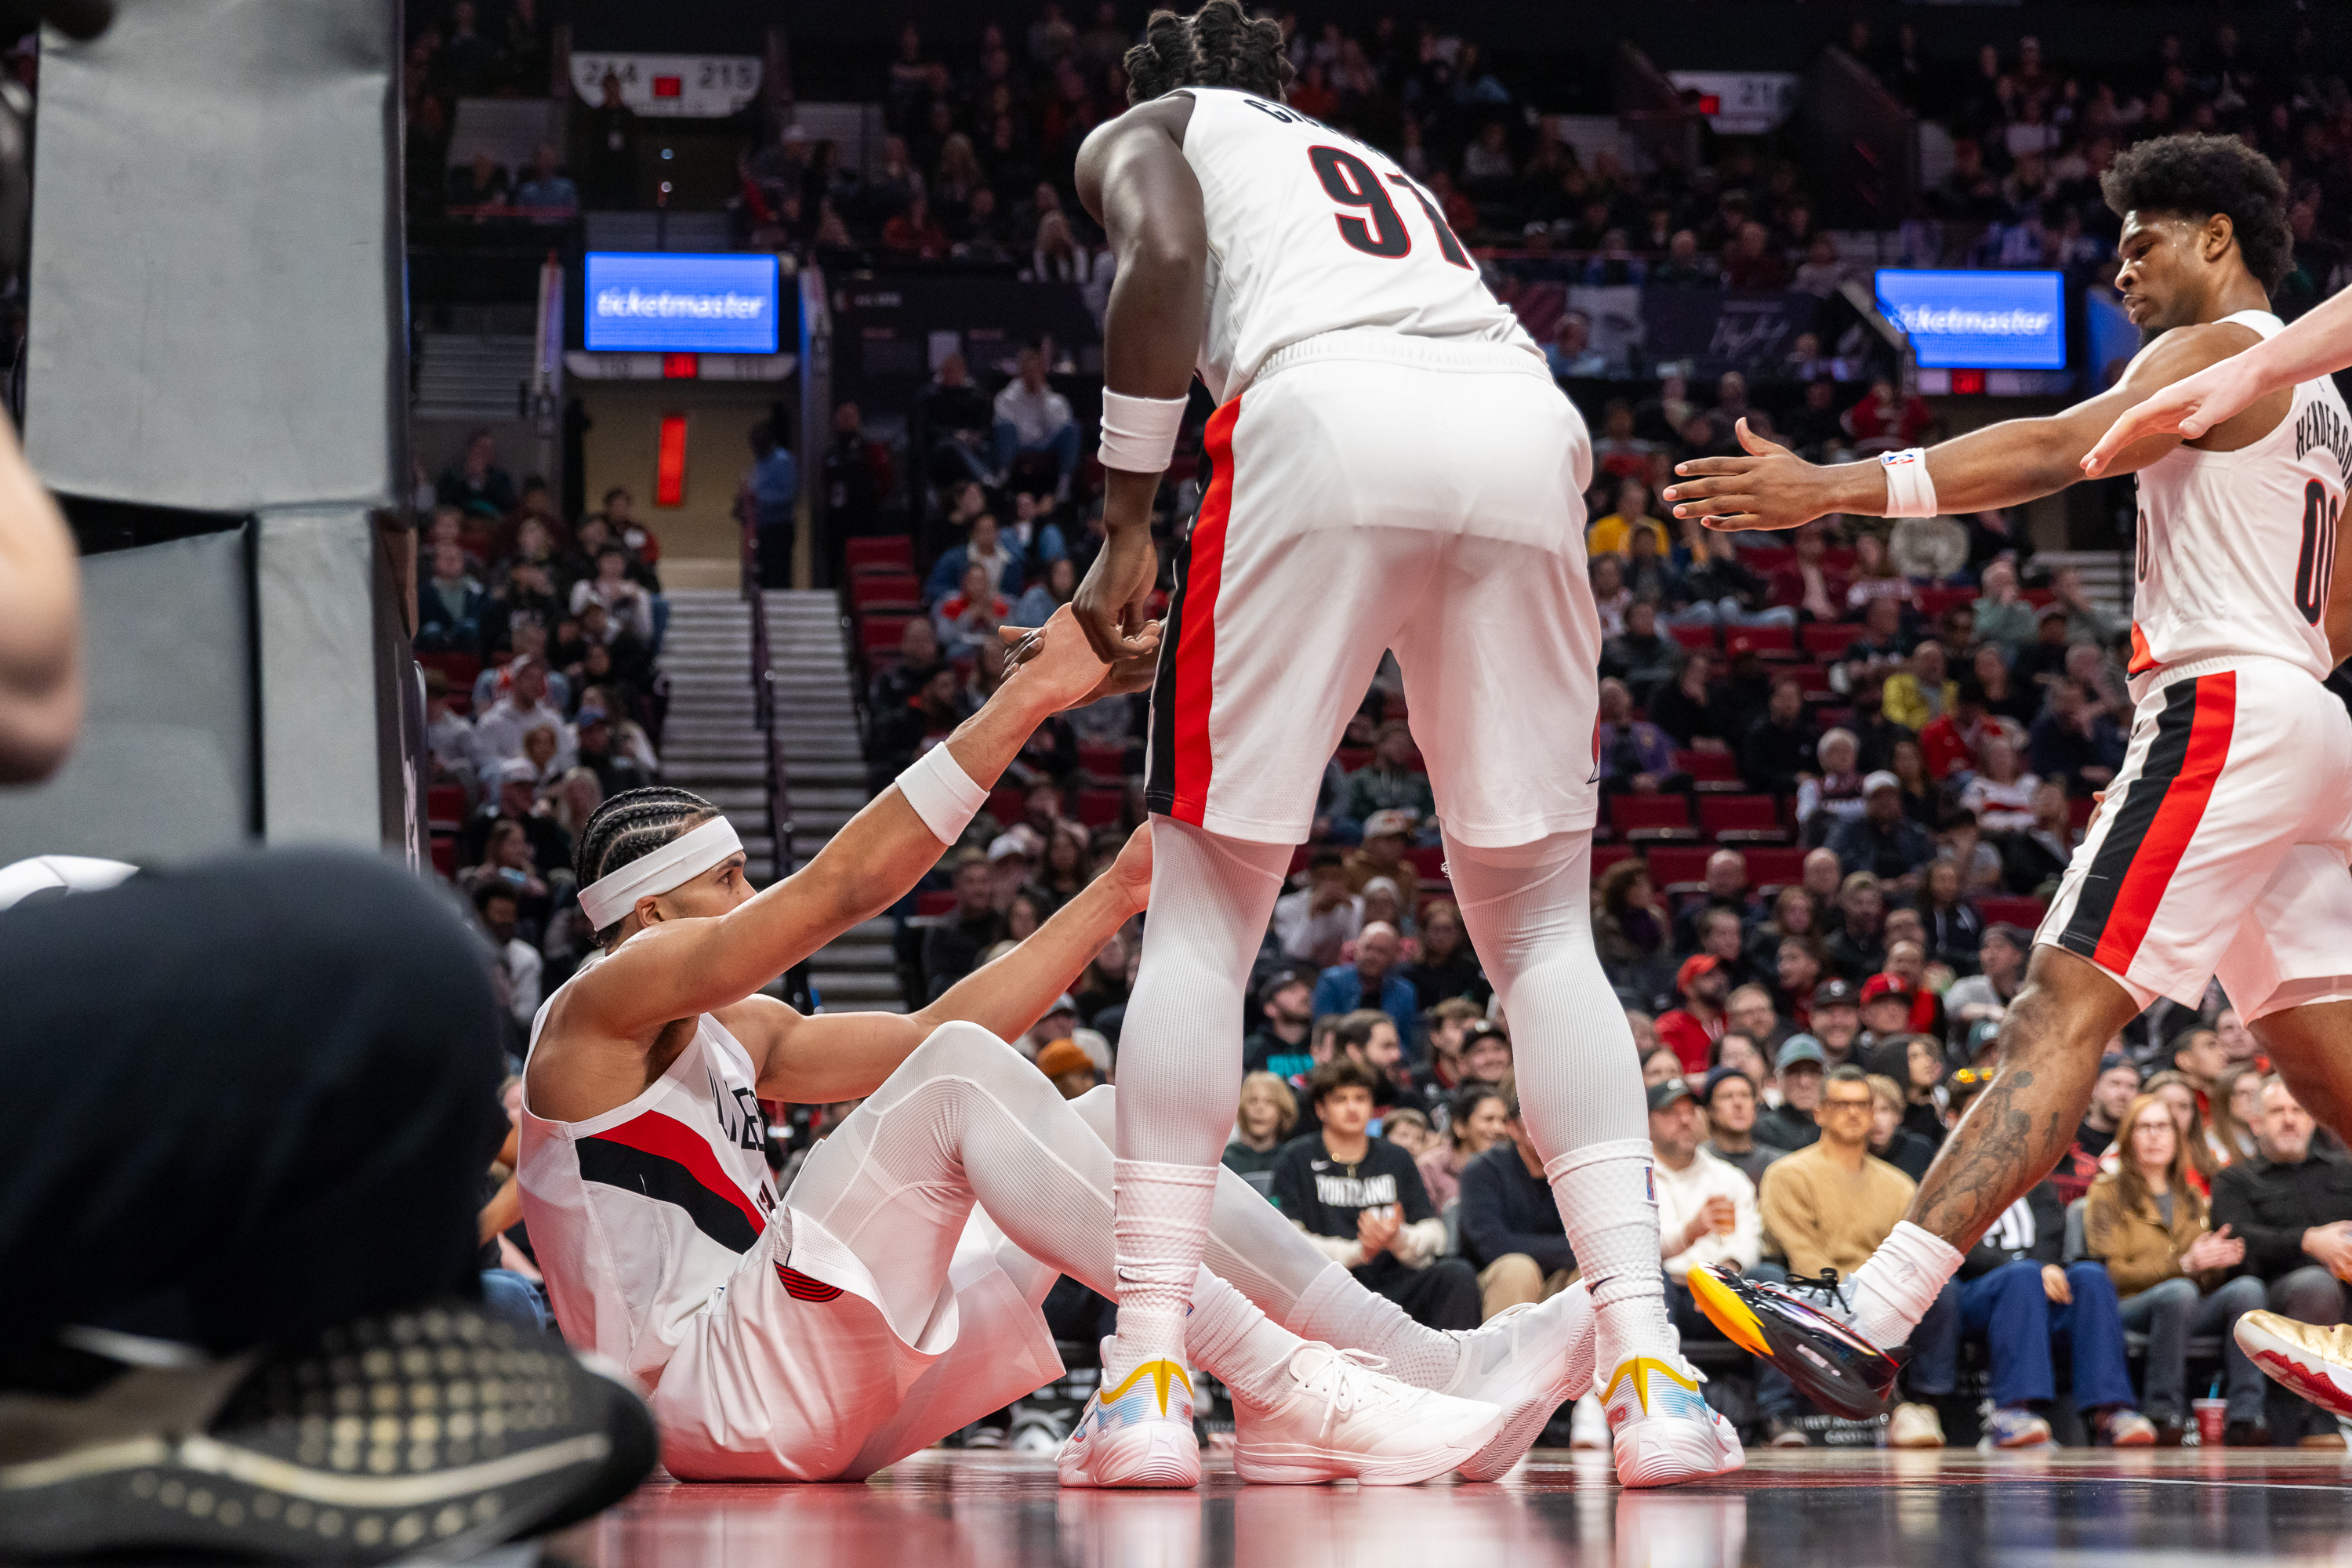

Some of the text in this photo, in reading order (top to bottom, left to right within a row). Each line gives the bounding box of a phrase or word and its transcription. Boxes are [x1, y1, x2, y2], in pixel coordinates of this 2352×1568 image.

[597, 287, 766, 318] ticketmaster
[1889, 303, 2051, 336] icketmaster
[1315, 1174, 1397, 1207] PORTLAND
